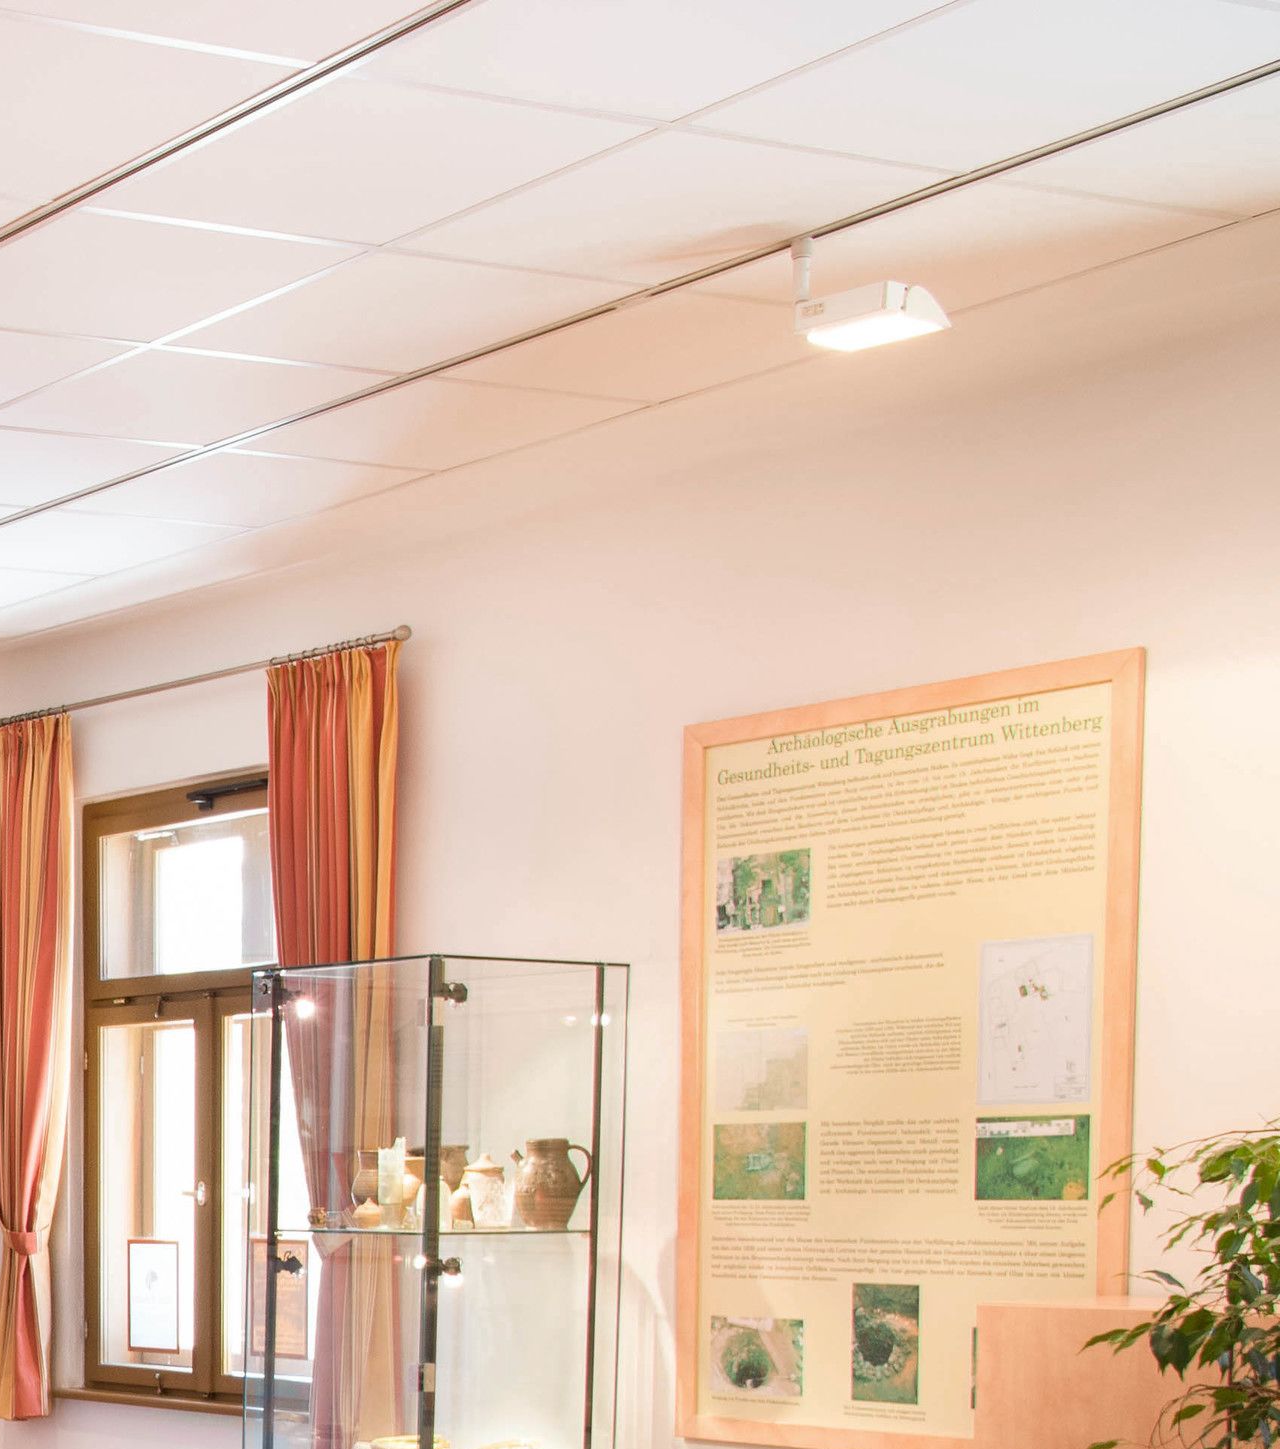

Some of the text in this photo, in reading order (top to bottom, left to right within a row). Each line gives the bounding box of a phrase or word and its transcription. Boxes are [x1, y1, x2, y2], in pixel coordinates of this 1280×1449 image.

[717, 715, 1104, 786] Gesundheits- und Tagungszentrum Wittenberg
[767, 698, 1040, 755] Archäologische Ausgrabungen im
